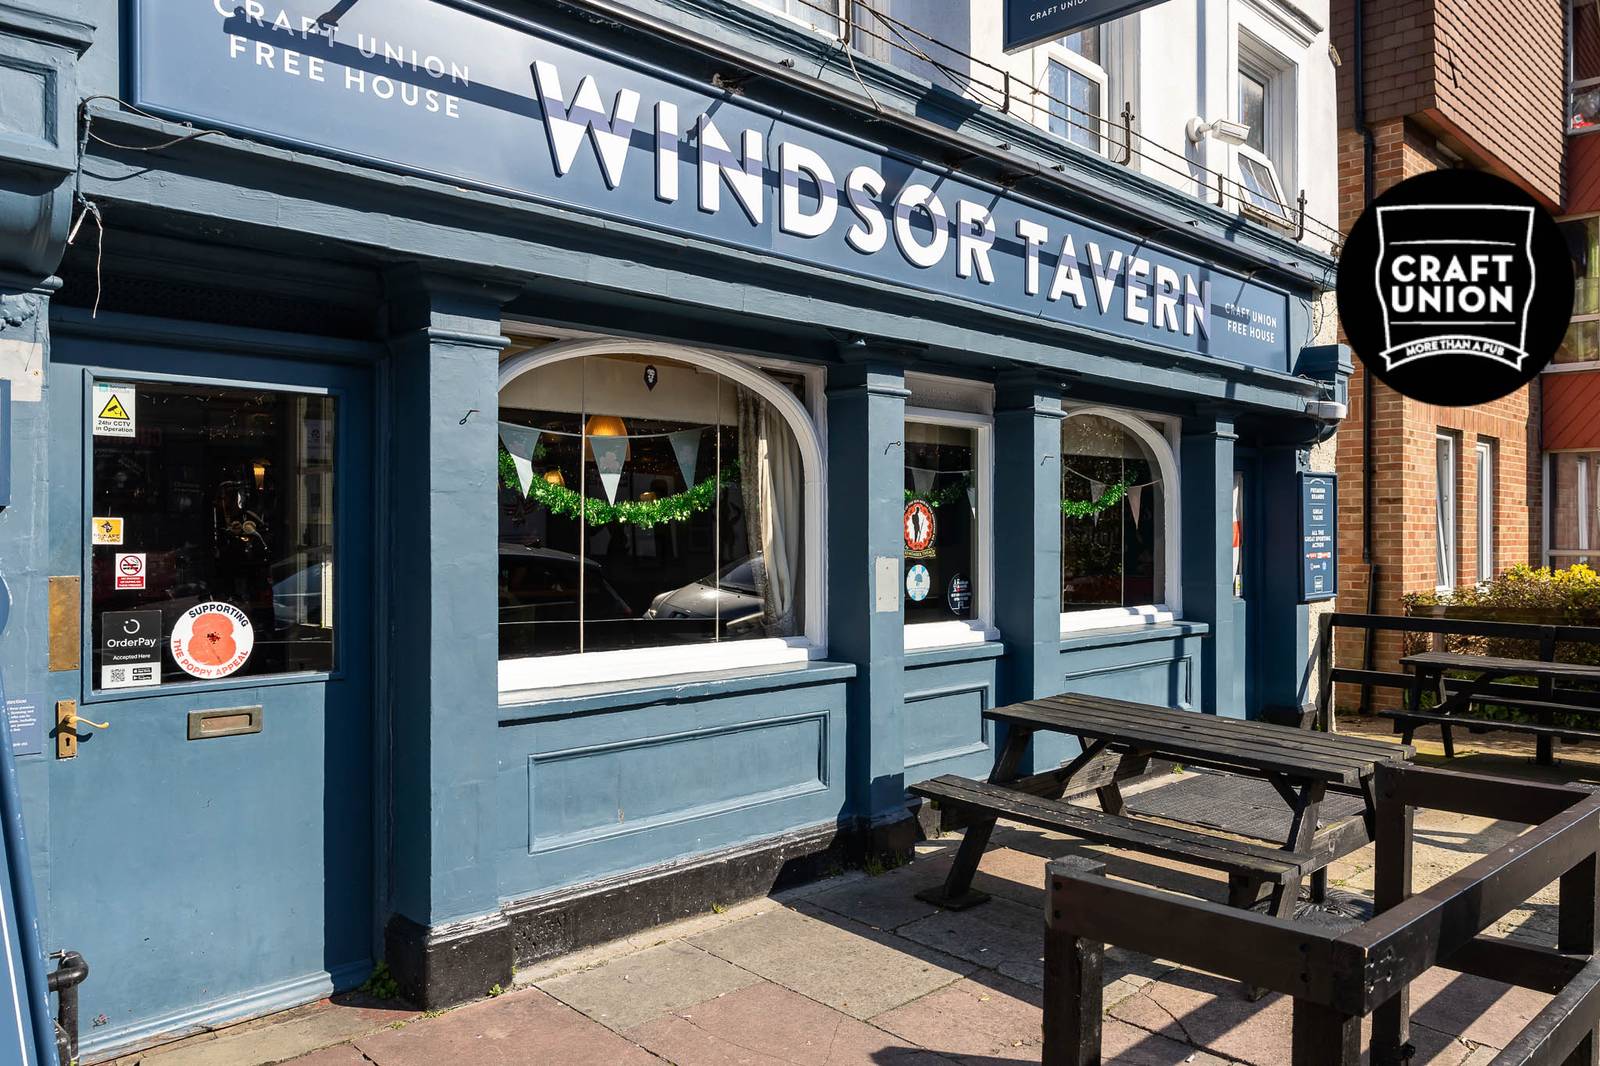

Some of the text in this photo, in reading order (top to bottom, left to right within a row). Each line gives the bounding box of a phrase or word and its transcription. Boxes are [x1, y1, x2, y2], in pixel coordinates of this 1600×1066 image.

[1029, 5, 1057, 21] CRAFT
[213, 0, 470, 87] CRAFT UNION
[229, 33, 461, 119] FREE HOUSE
[530, 59, 1212, 341] WINDSOR TAVERN
[1224, 302, 1277, 328] CRAFT UNION
[1227, 320, 1275, 343] FREE HOUSE
[189, 604, 249, 627] SUPPORTING
[107, 637, 156, 648] OrderPay
[173, 639, 249, 677] THE POPPY APPEAL
